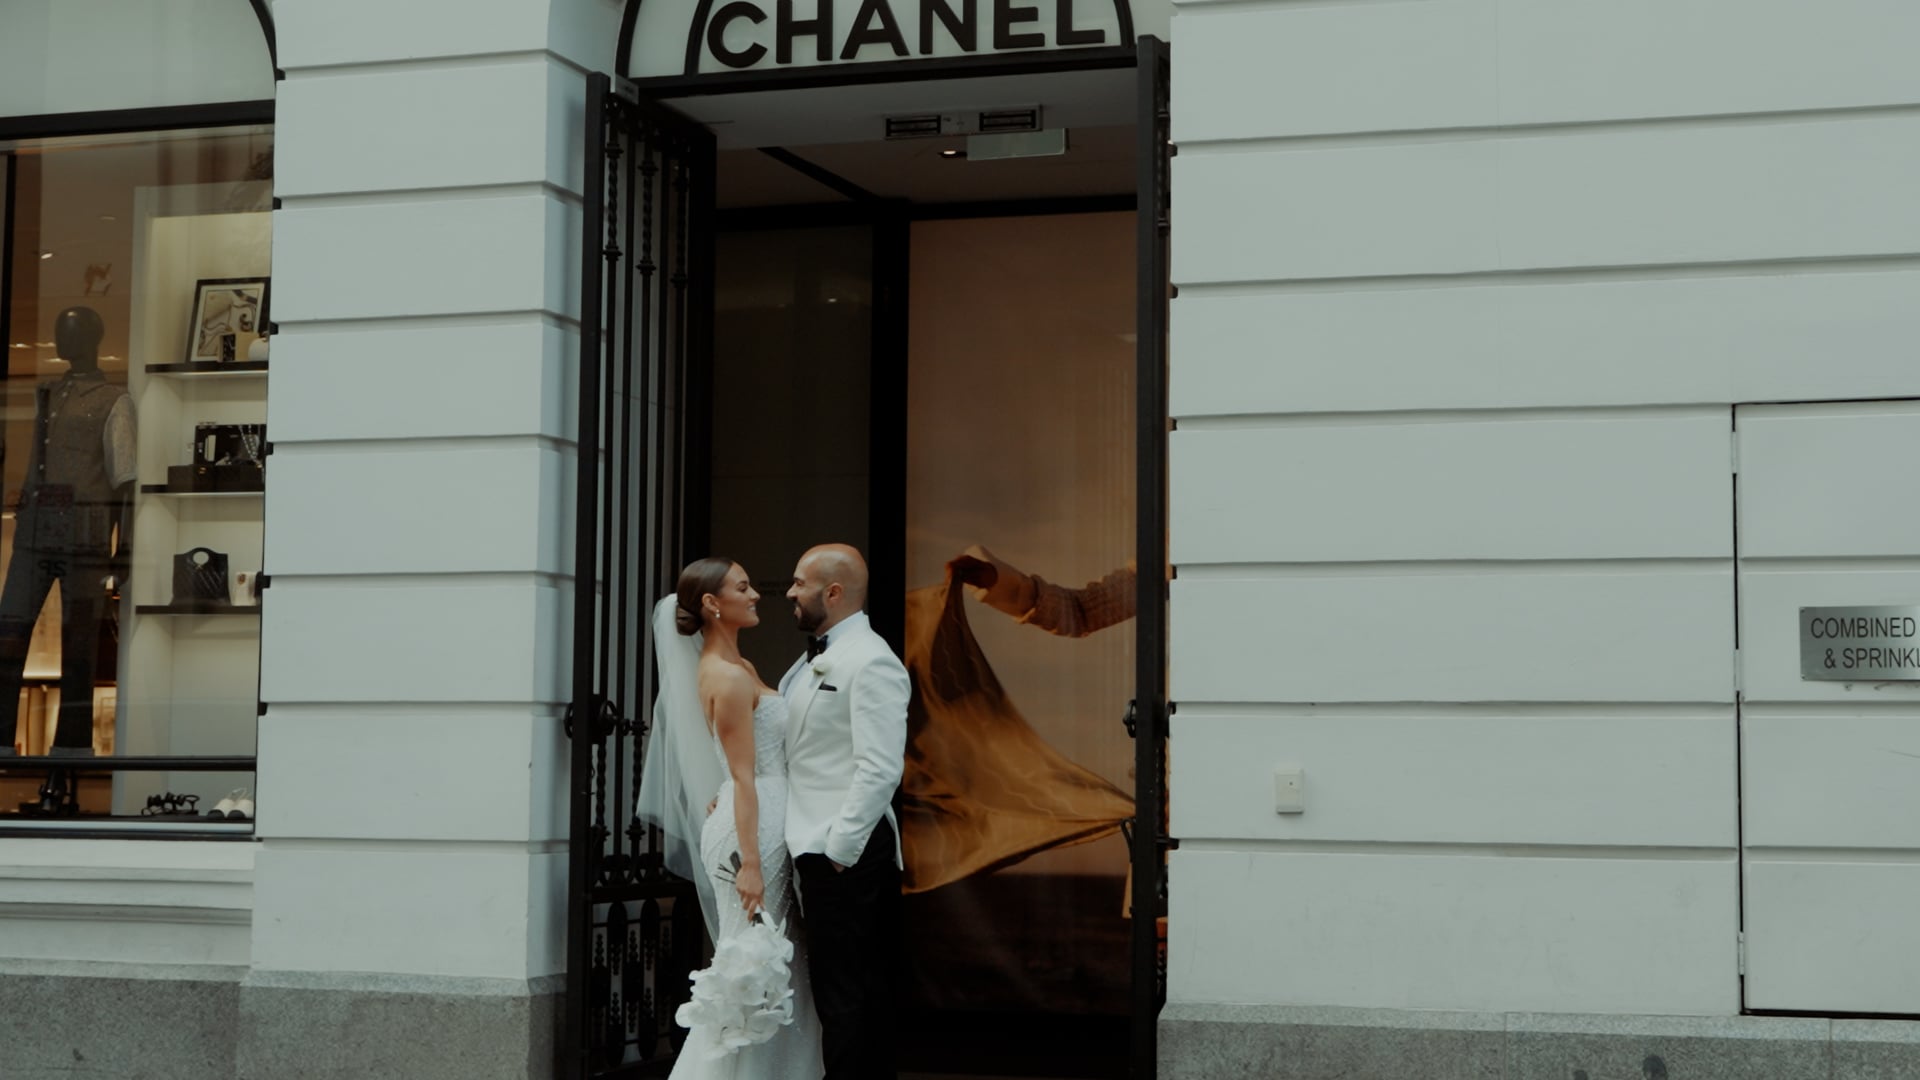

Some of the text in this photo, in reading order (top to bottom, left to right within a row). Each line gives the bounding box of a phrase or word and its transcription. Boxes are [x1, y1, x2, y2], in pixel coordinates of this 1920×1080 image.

[707, 0, 1106, 68] CHANEL
[1811, 617, 1916, 638] COMBINED
[1823, 648, 1837, 669] &
